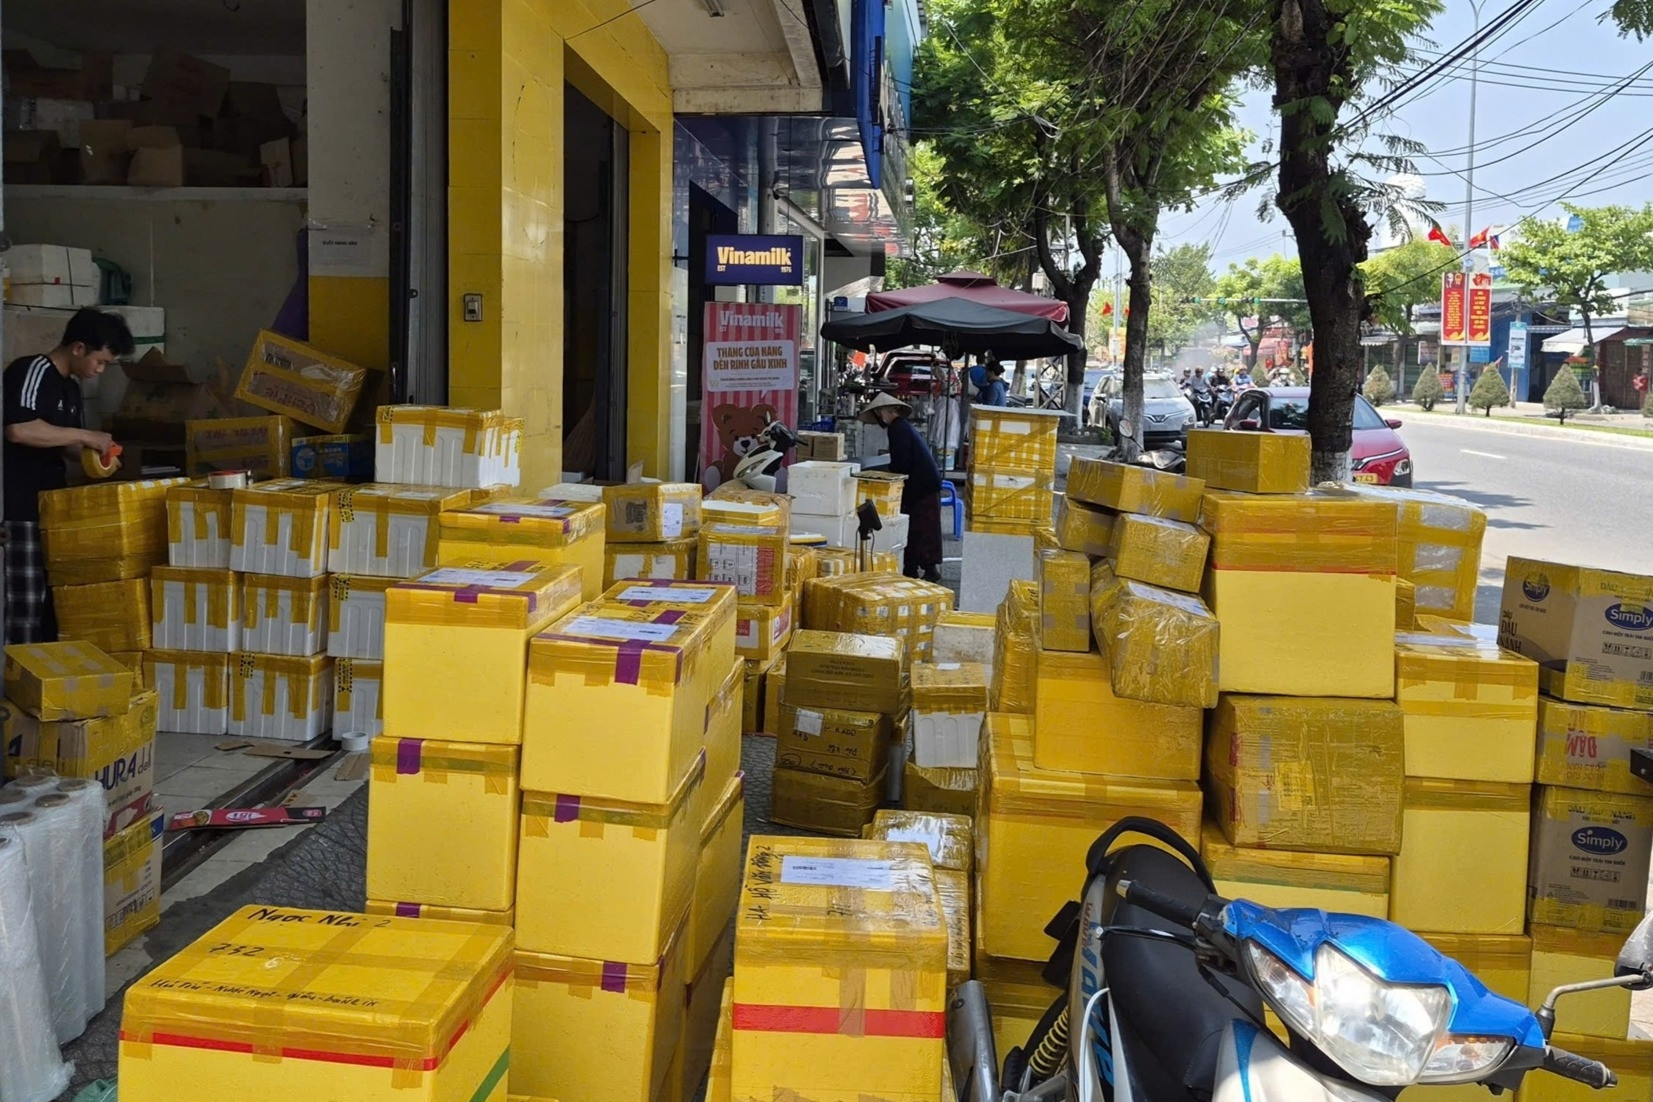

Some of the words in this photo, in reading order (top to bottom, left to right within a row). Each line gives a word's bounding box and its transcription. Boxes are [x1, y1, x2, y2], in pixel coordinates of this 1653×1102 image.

[716, 246, 792, 265] Vinamilk
[720, 310, 784, 327] Vinamilk
[730, 358, 749, 370] RINH
[768, 357, 787, 369] XINH
[1577, 829, 1623, 850] Simply
[374, 919, 392, 929] 2
